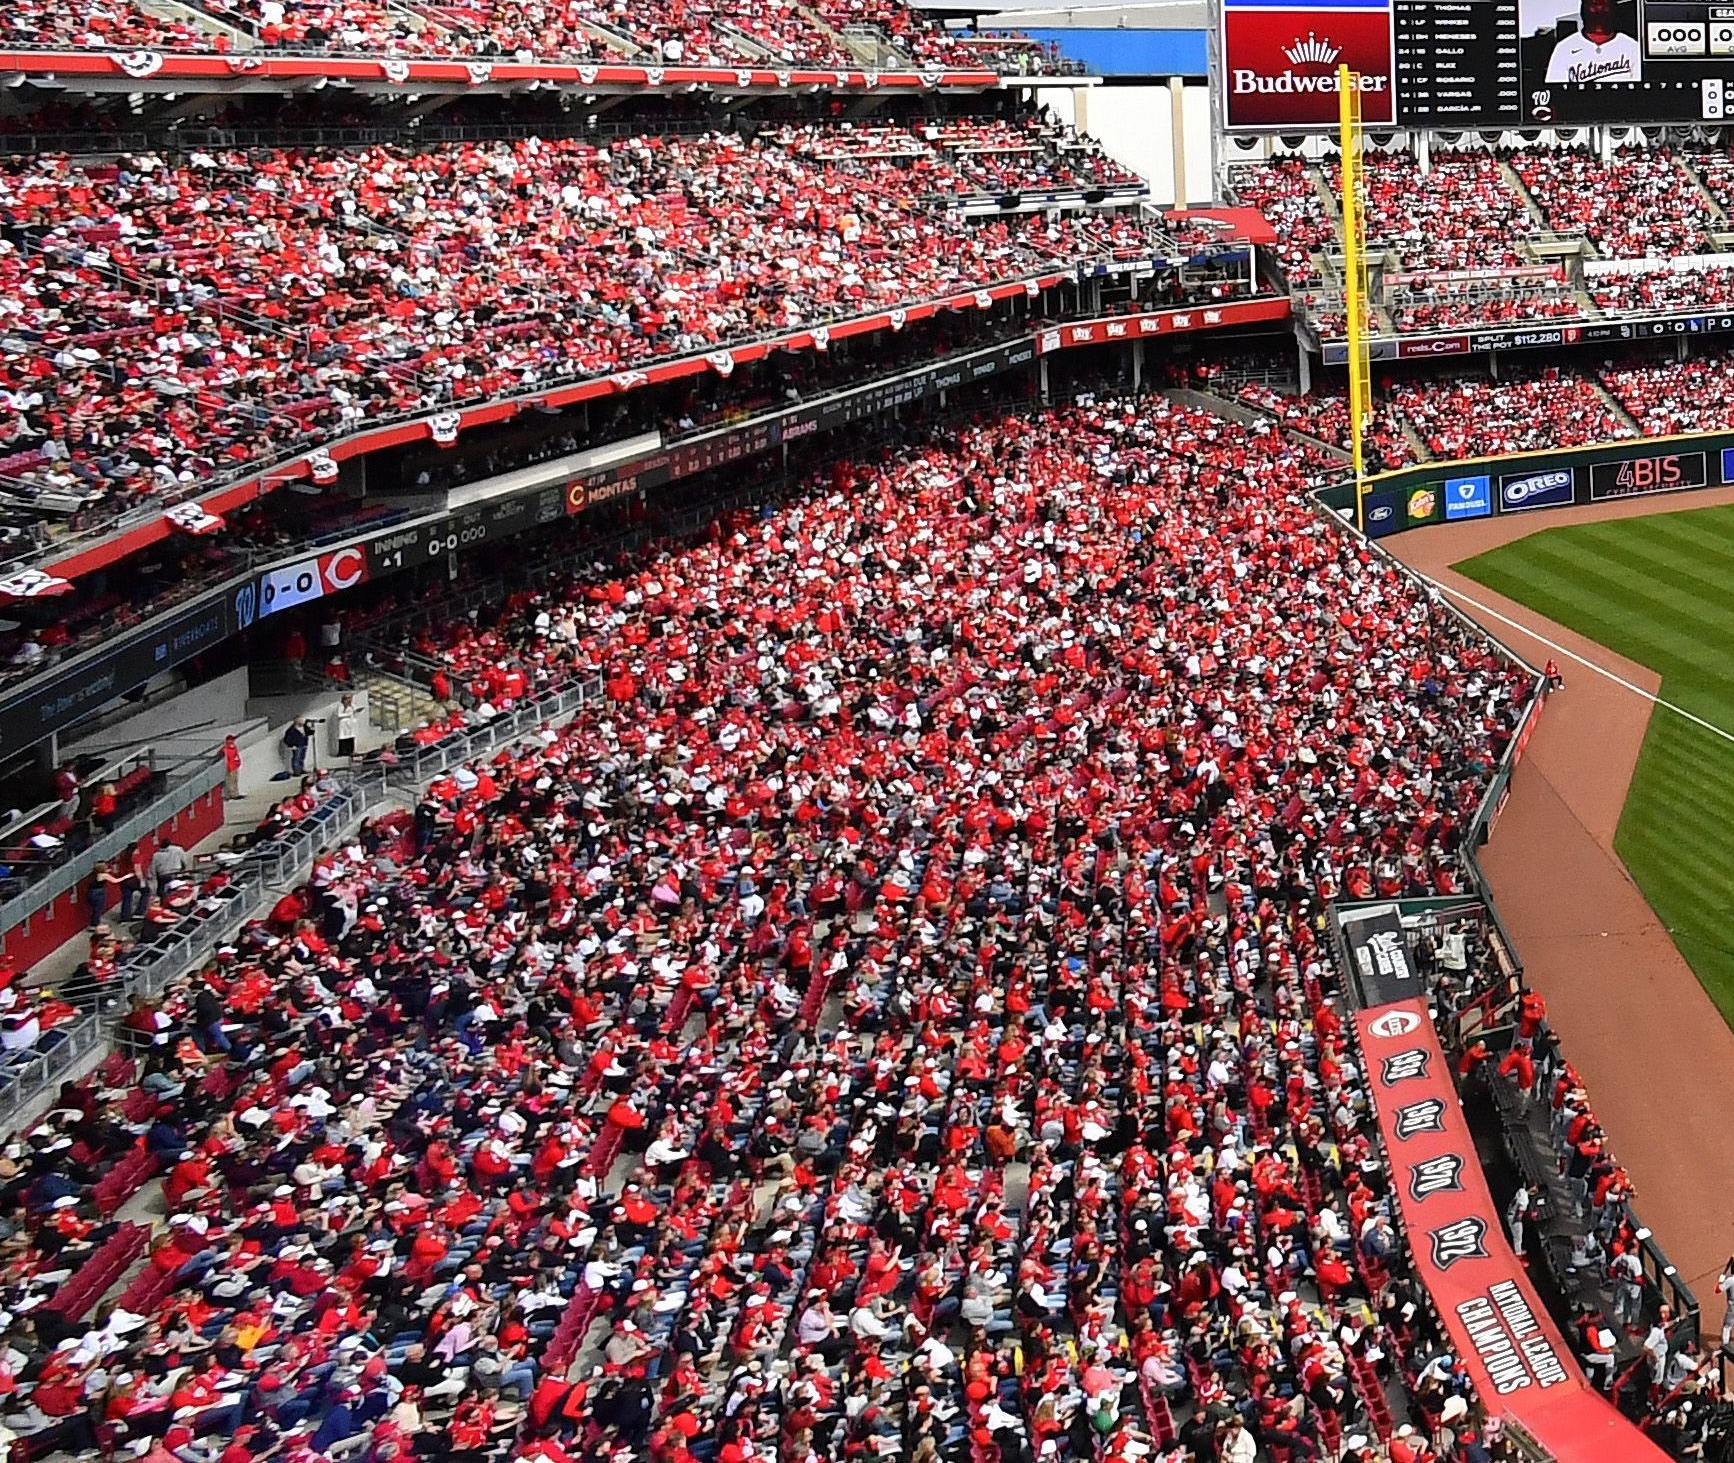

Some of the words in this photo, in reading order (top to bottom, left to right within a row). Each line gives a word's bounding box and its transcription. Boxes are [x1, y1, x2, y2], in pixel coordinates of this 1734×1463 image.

[1652, 28, 1701, 42] .000
[1514, 333, 1560, 345] $112,280
[1505, 473, 1569, 499] OREO
[1616, 456, 1681, 488] 4BIS
[588, 477, 637, 502] MONTAS
[374, 531, 418, 556] INNING
[1417, 1156, 1457, 1193] 1970
[1438, 1220, 1480, 1261] 1972
[1455, 1296, 1534, 1395] CHAMPIONS
[1488, 1280, 1541, 1340] NATIONAL
[1520, 1335, 1569, 1389] LEAGUE
